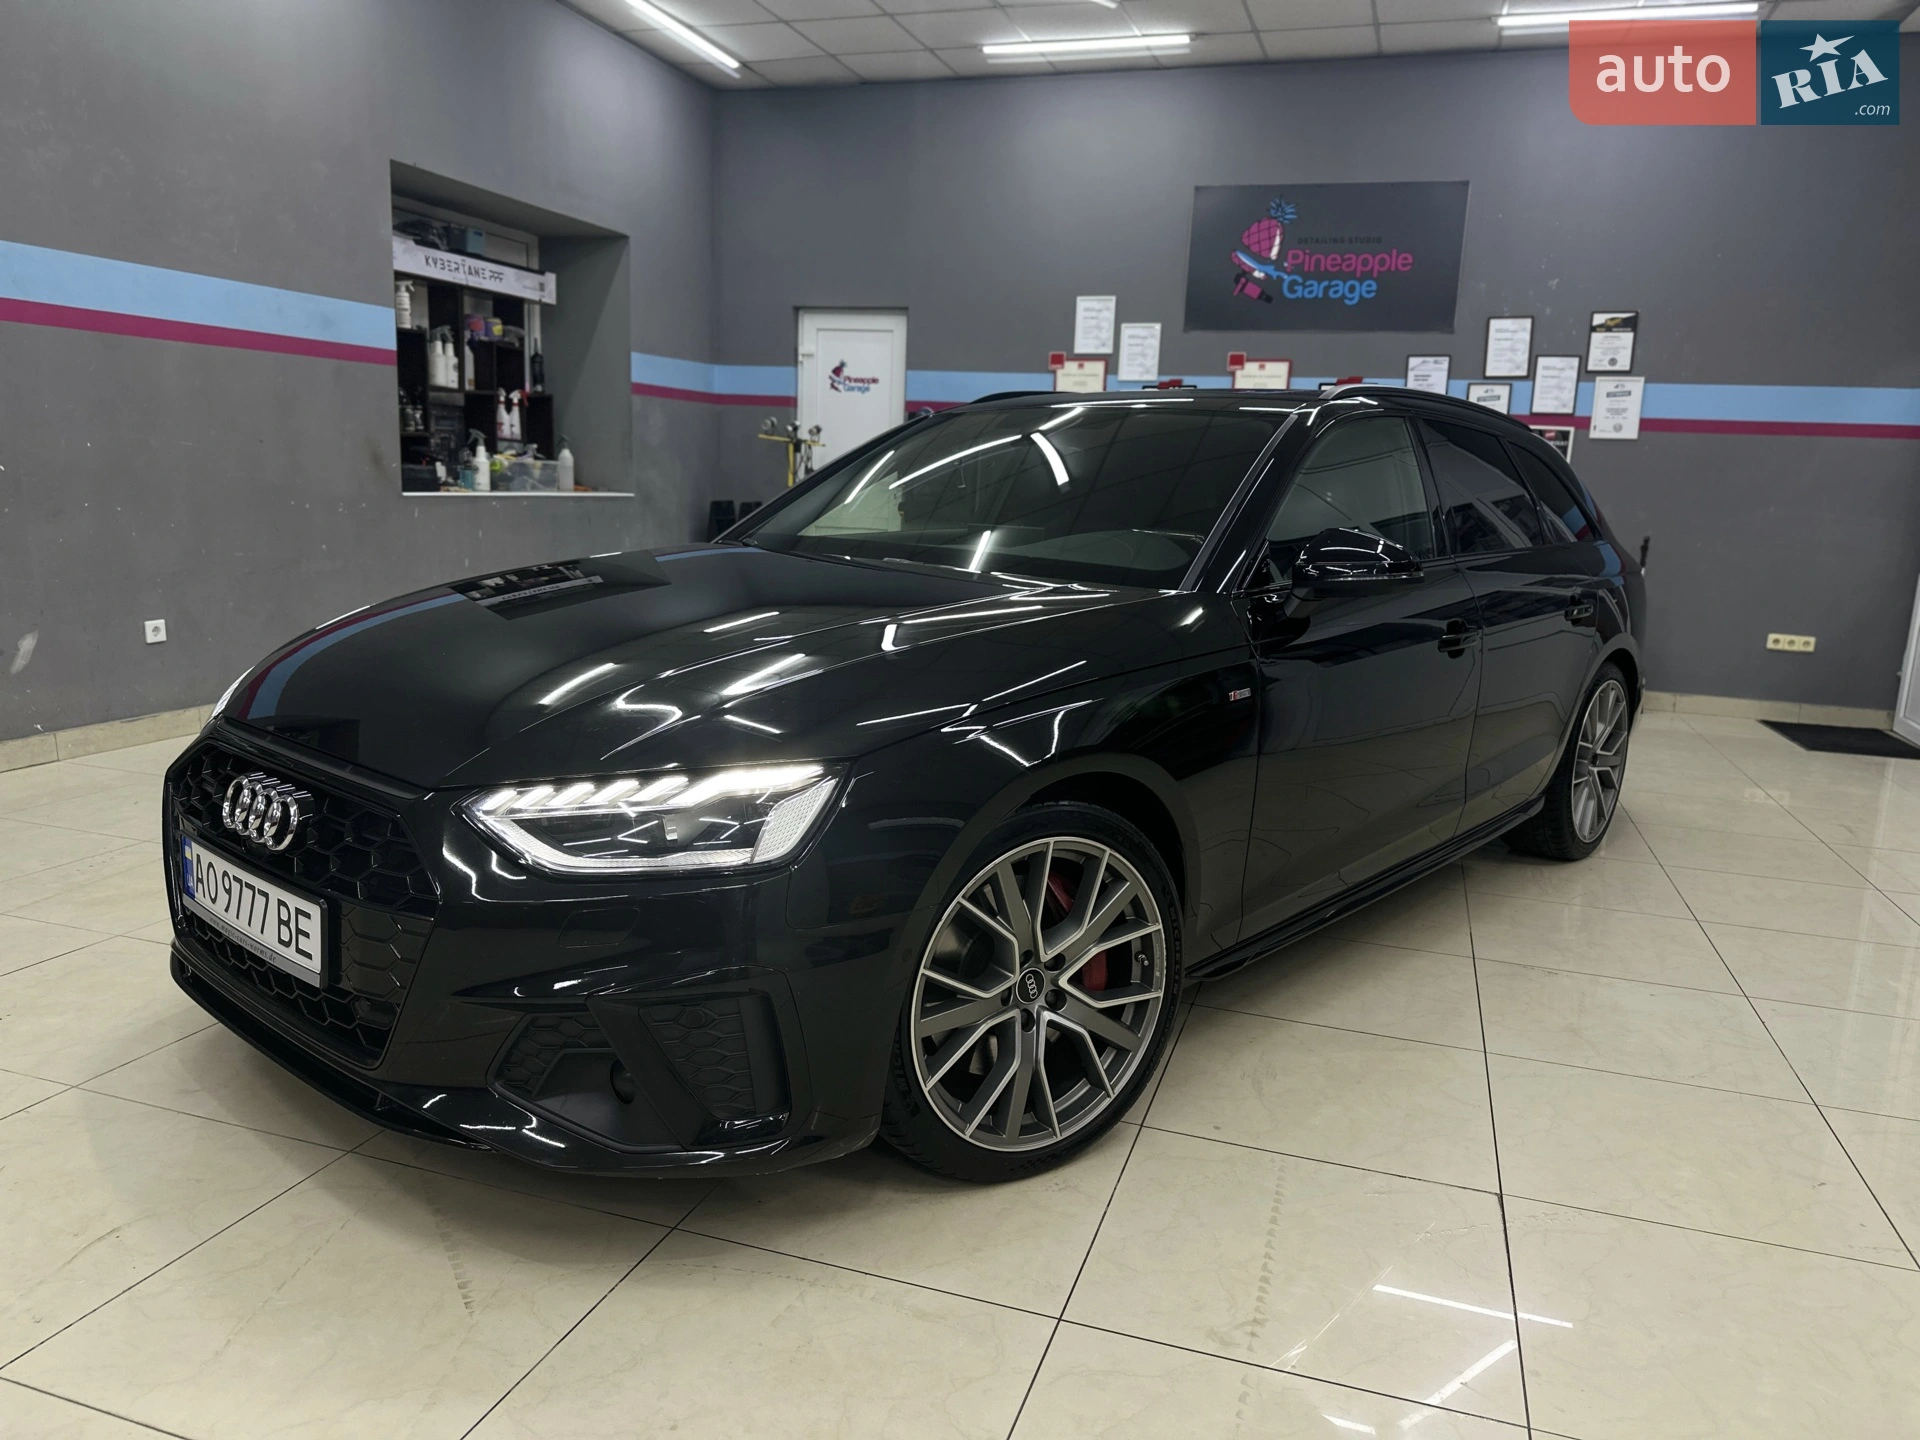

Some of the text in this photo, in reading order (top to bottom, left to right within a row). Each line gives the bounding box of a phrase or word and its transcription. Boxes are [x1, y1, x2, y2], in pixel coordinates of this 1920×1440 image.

[1297, 236, 1382, 245] DETAILING STUDIO
[1287, 249, 1413, 277] Pineapple
[1282, 275, 1377, 305] Garage
[843, 375, 879, 386] Pineapple
[843, 385, 870, 394] Garage
[196, 853, 313, 961] AO 9777 BE
